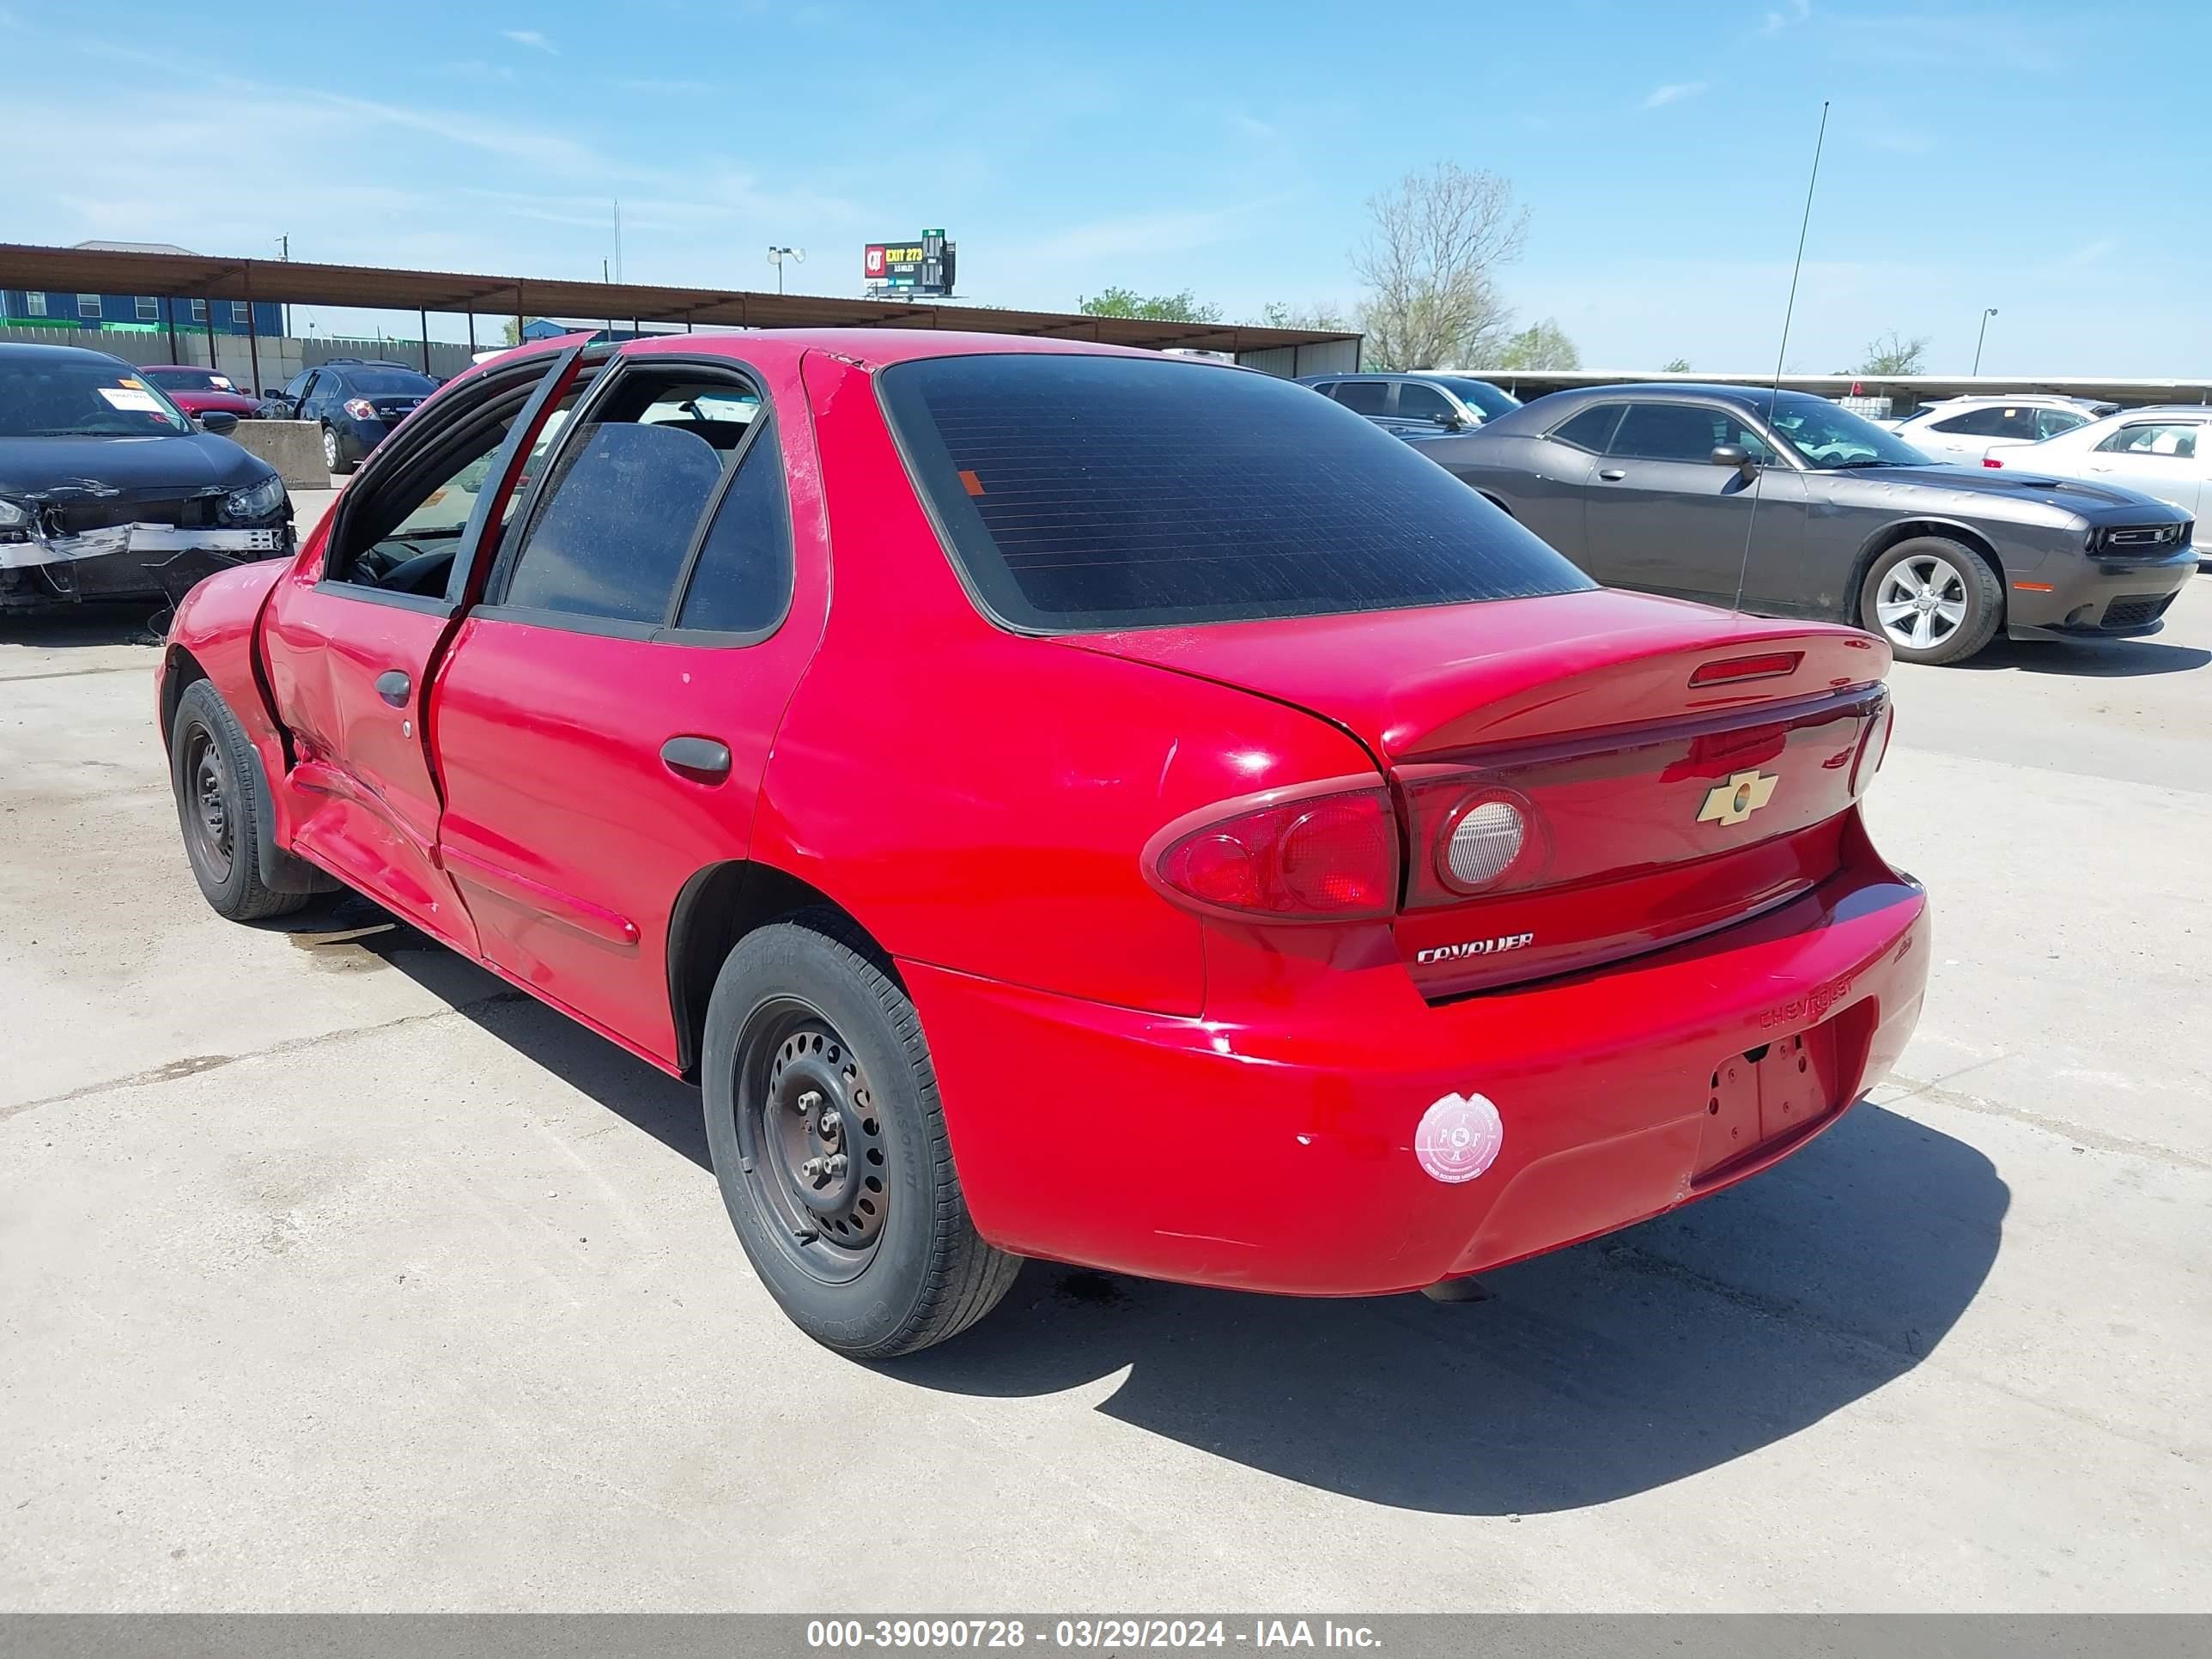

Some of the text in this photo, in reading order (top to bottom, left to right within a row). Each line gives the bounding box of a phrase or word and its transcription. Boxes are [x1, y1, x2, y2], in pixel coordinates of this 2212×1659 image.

[885, 247, 922, 262] EXIT 273
[1417, 933, 1534, 963] CAVALIER
[1759, 975, 1854, 1030] CHEVROLET
